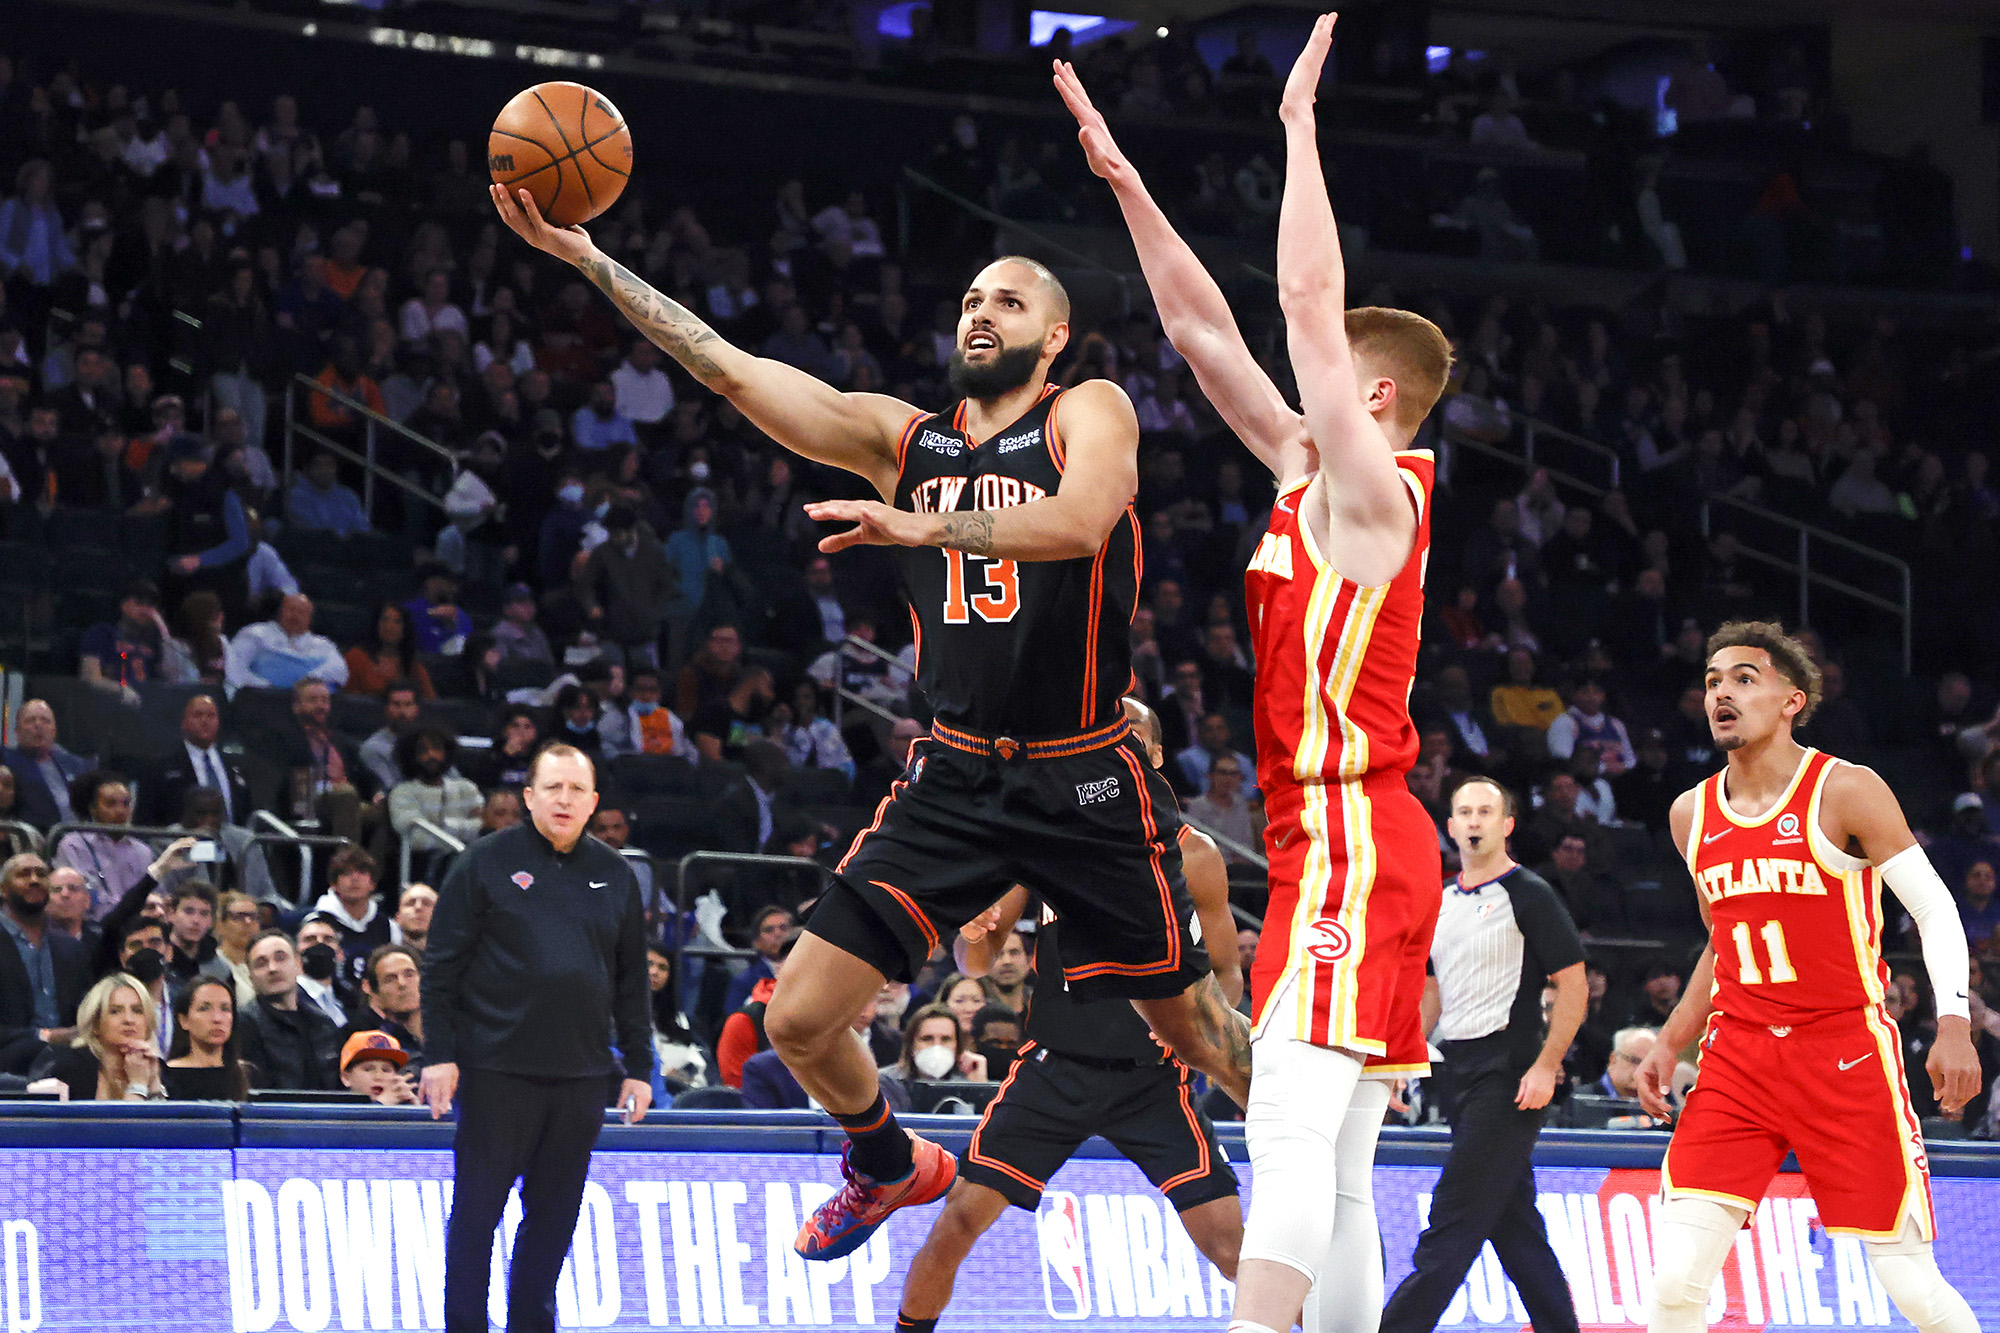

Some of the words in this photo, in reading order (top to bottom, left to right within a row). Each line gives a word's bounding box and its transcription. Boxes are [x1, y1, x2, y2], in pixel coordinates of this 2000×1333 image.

[998, 429, 1040, 447] SQUARE
[998, 439, 1031, 455] SPACE
[910, 475, 968, 514] NEW
[973, 473, 1047, 512] YORK
[943, 547, 1021, 624] 13
[1076, 777, 1120, 805] NYC
[1697, 858, 1828, 904] ATLANTA
[1732, 920, 1797, 984] 11
[624, 1181, 759, 1326] THE
[765, 1182, 890, 1325] APP
[1085, 1194, 1208, 1318] NBA
